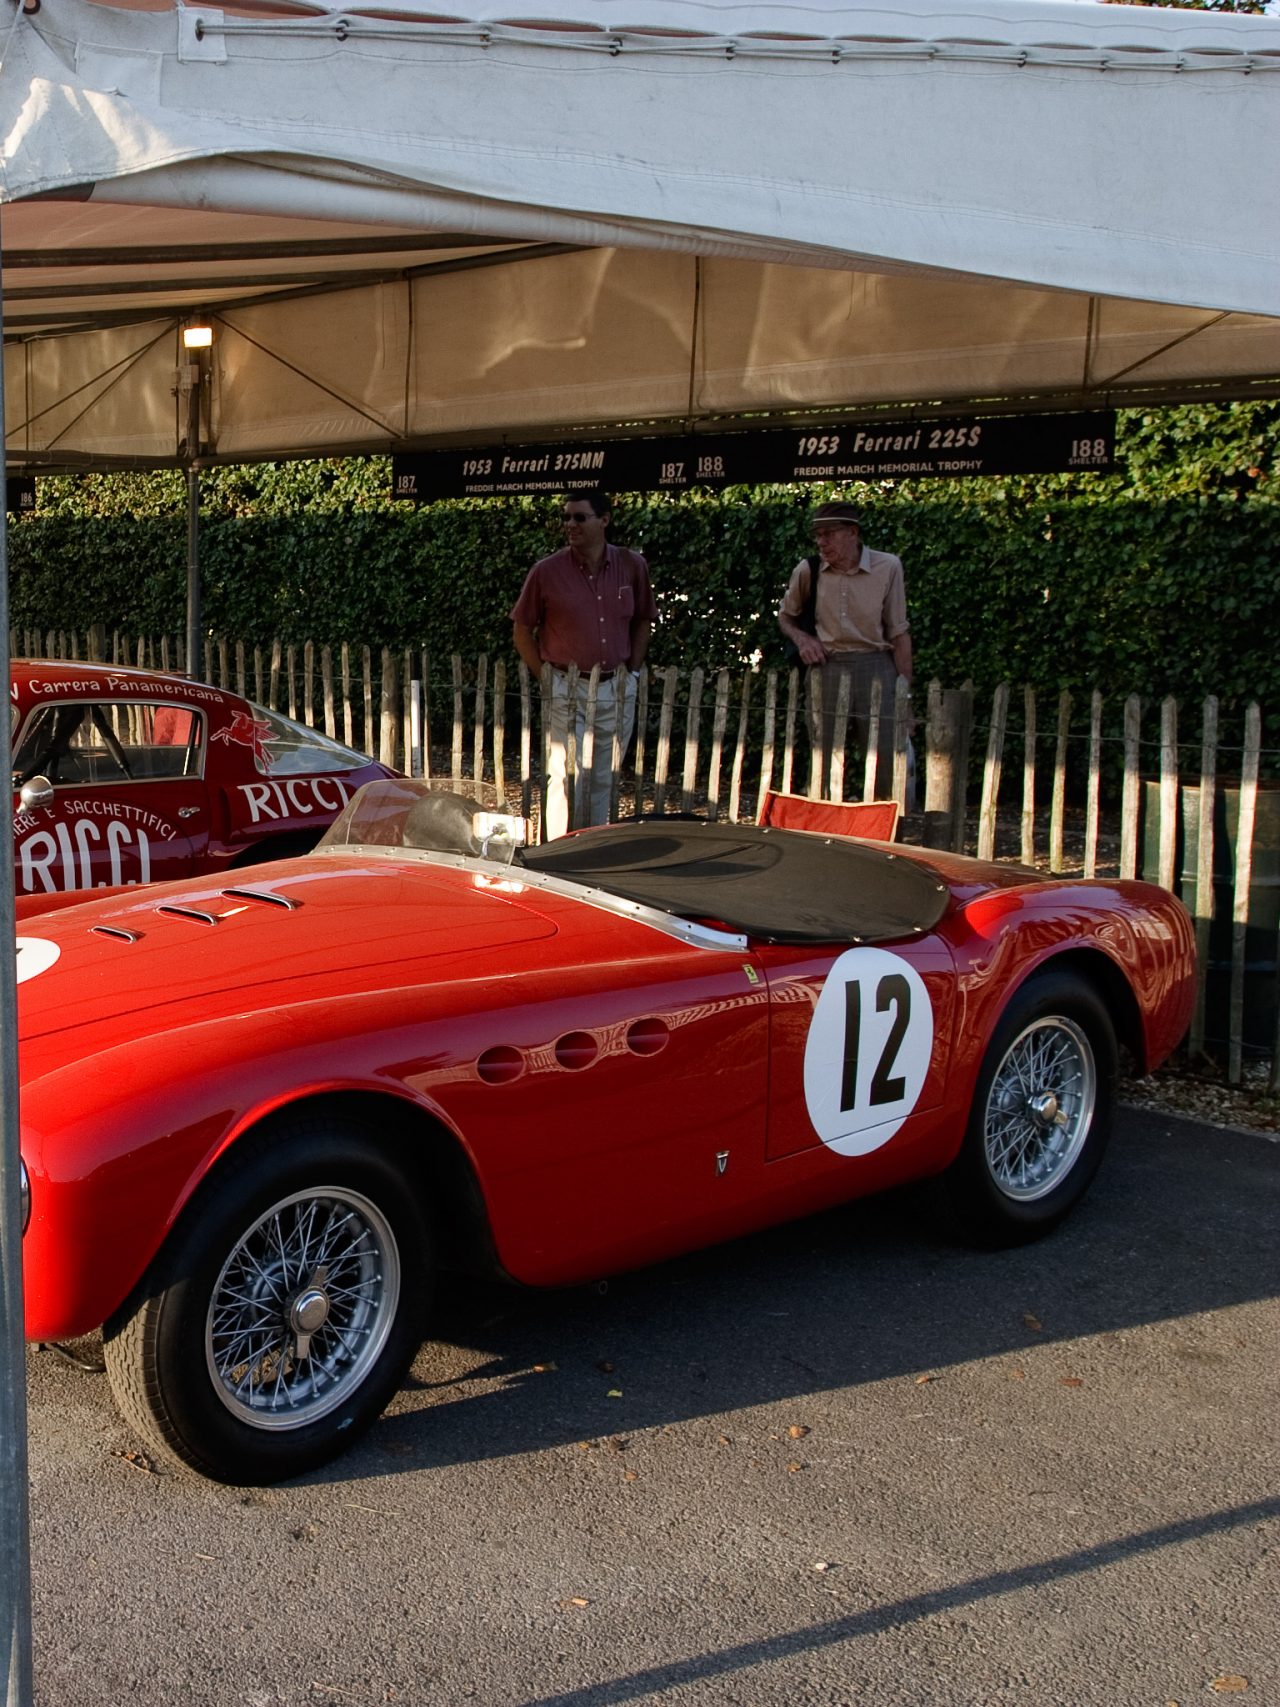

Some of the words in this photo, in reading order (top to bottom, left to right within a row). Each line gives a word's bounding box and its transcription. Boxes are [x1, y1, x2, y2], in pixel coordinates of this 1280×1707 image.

[798, 436, 840, 456] 1953
[853, 431, 921, 453] Ferrari
[928, 426, 982, 449] 225S
[1072, 439, 1106, 457] 188
[463, 459, 492, 476] 1953
[501, 455, 549, 473] Ferrari
[554, 451, 605, 470] 375MM
[698, 456, 723, 472] 188
[794, 466, 834, 476] FREDDIE
[837, 464, 875, 475] MARCH
[878, 462, 933, 473] MEMORIAL
[938, 460, 983, 471] TROPHY
[1069, 456, 1108, 466] SHELTER
[662, 463, 685, 478] 187
[696, 470, 725, 479] SHELTER
[398, 475, 415, 488] 187
[466, 484, 494, 492] FREDDIE
[496, 483, 523, 491] MARCH
[525, 481, 565, 490] MEMORIAL
[567, 480, 599, 489] TROPHY
[29, 679, 100, 695] Carrera
[105, 676, 225, 704] Panamericana
[237, 777, 350, 822] RICCI
[64, 800, 177, 841] SACCHETTIFICI
[20, 818, 151, 893] RICCI
[839, 973, 912, 1113] 12
